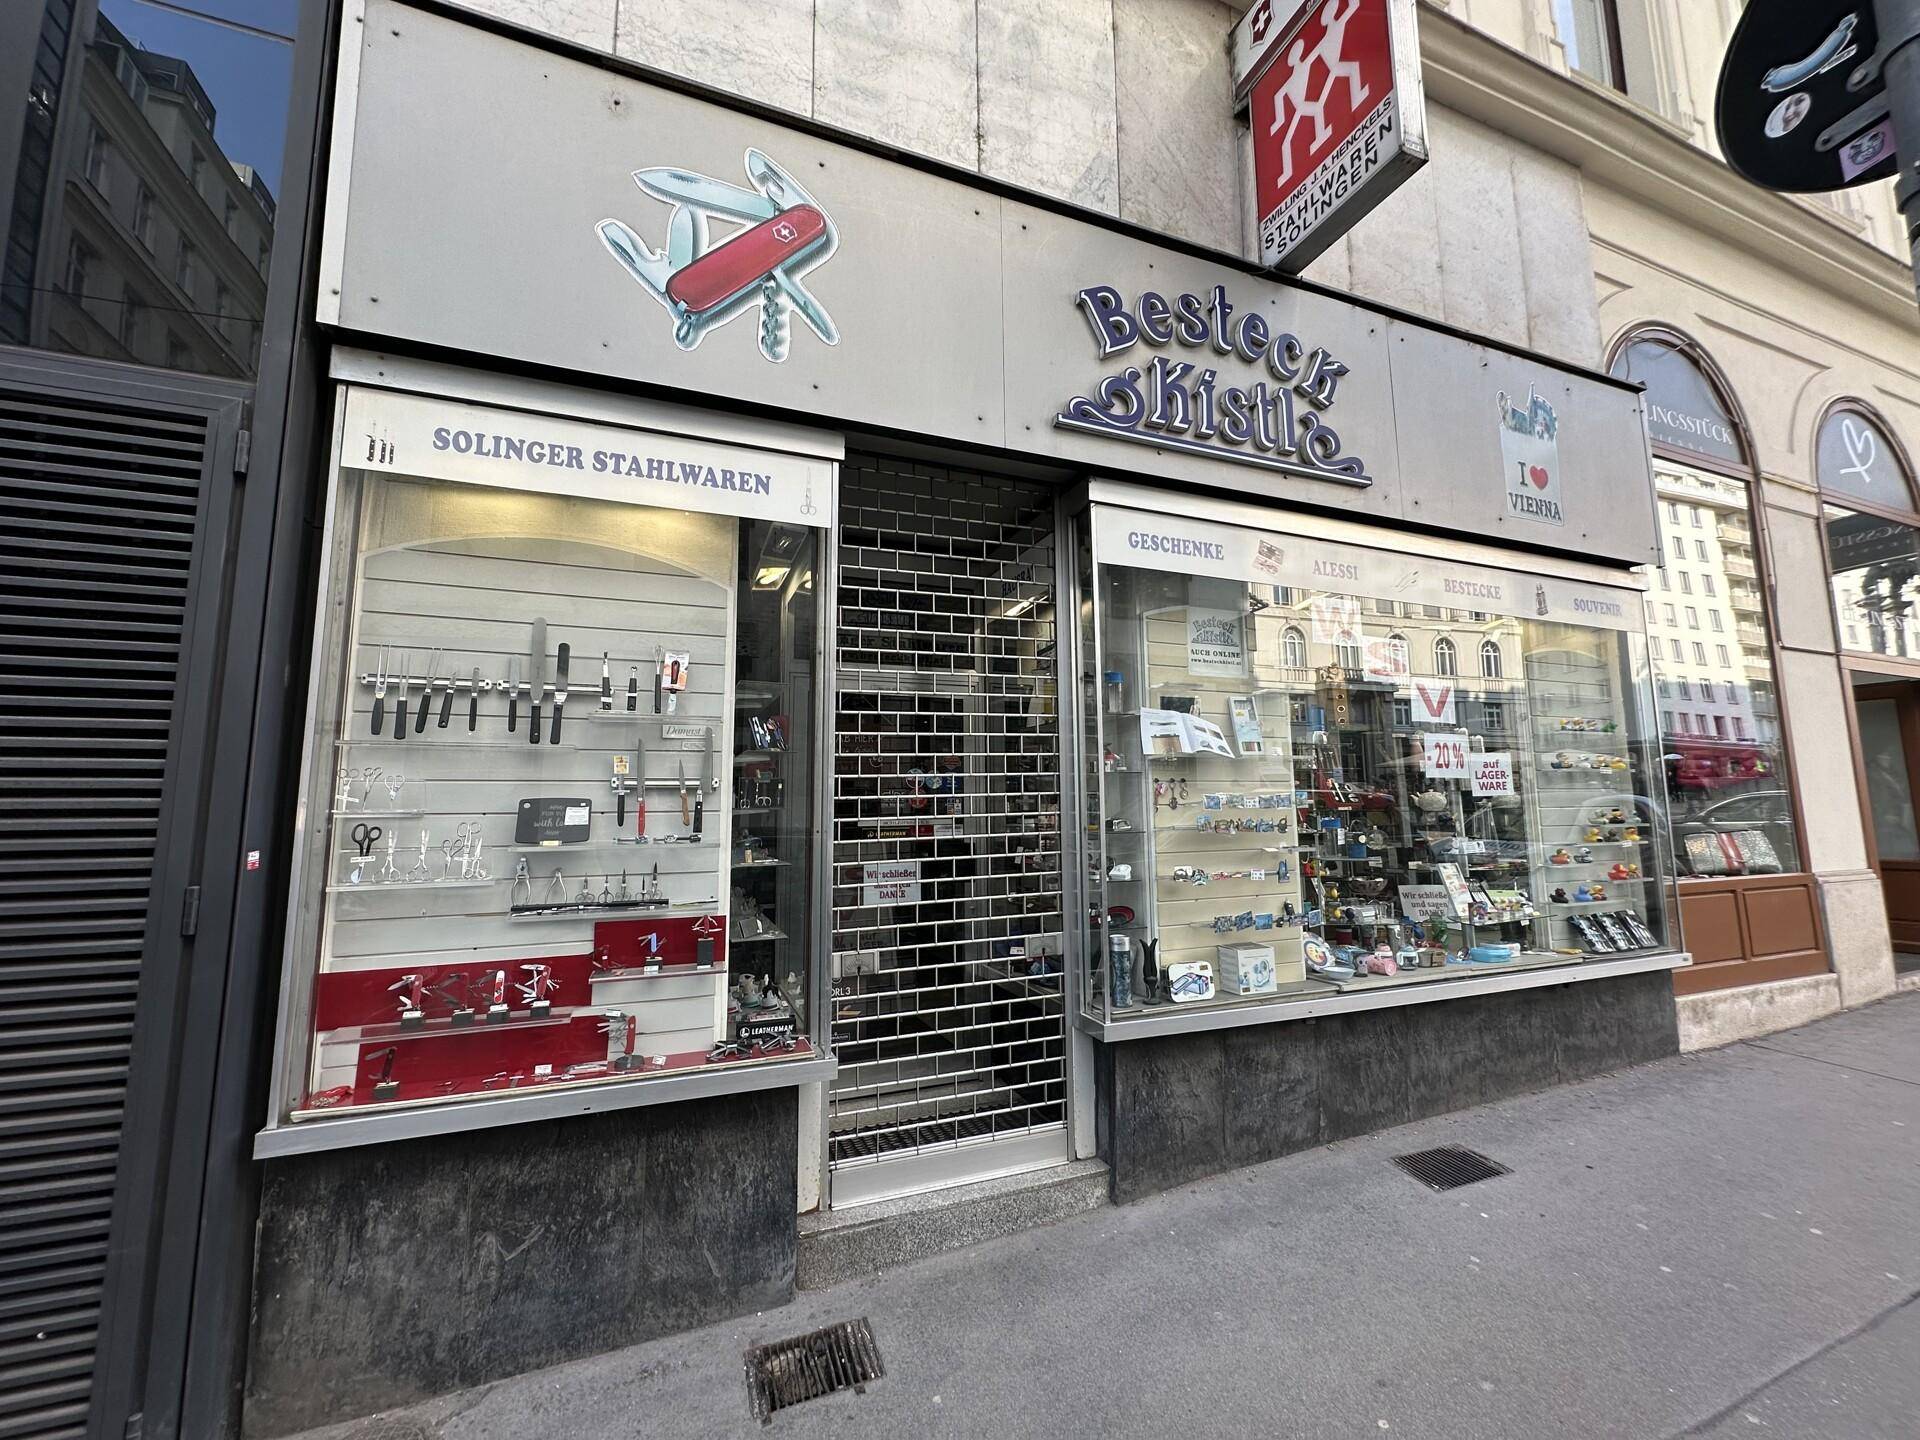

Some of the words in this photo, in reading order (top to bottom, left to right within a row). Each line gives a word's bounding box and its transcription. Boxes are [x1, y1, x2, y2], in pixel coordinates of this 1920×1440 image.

[1263, 184, 1307, 231] ZWILLING
[1331, 97, 1391, 165] HENCKELS
[1265, 115, 1392, 250] STAHLWAREN
[1278, 150, 1378, 254] SOLINGEN
[1075, 285, 1350, 410] Besteck
[1649, 405, 1733, 444] INGSSTÜCK
[433, 427, 584, 470] SOLINGER
[592, 451, 772, 496] STAHLWAREN
[1518, 461, 1528, 487] I
[1508, 492, 1562, 521] VIENNA
[1128, 531, 1225, 561] GESCHENKE
[1312, 559, 1359, 581] ALESSI
[1444, 578, 1502, 600] BESTECKE
[1212, 650, 1240, 658] ONLINE
[1475, 770, 1509, 780] LAGER-
[1483, 759, 1499, 768] auf
[1478, 781, 1507, 790] WARE
[875, 830, 906, 838] LATHERMAN
[1428, 902, 1448, 910] sagen
[752, 1025, 794, 1035] LEATHERMAN
